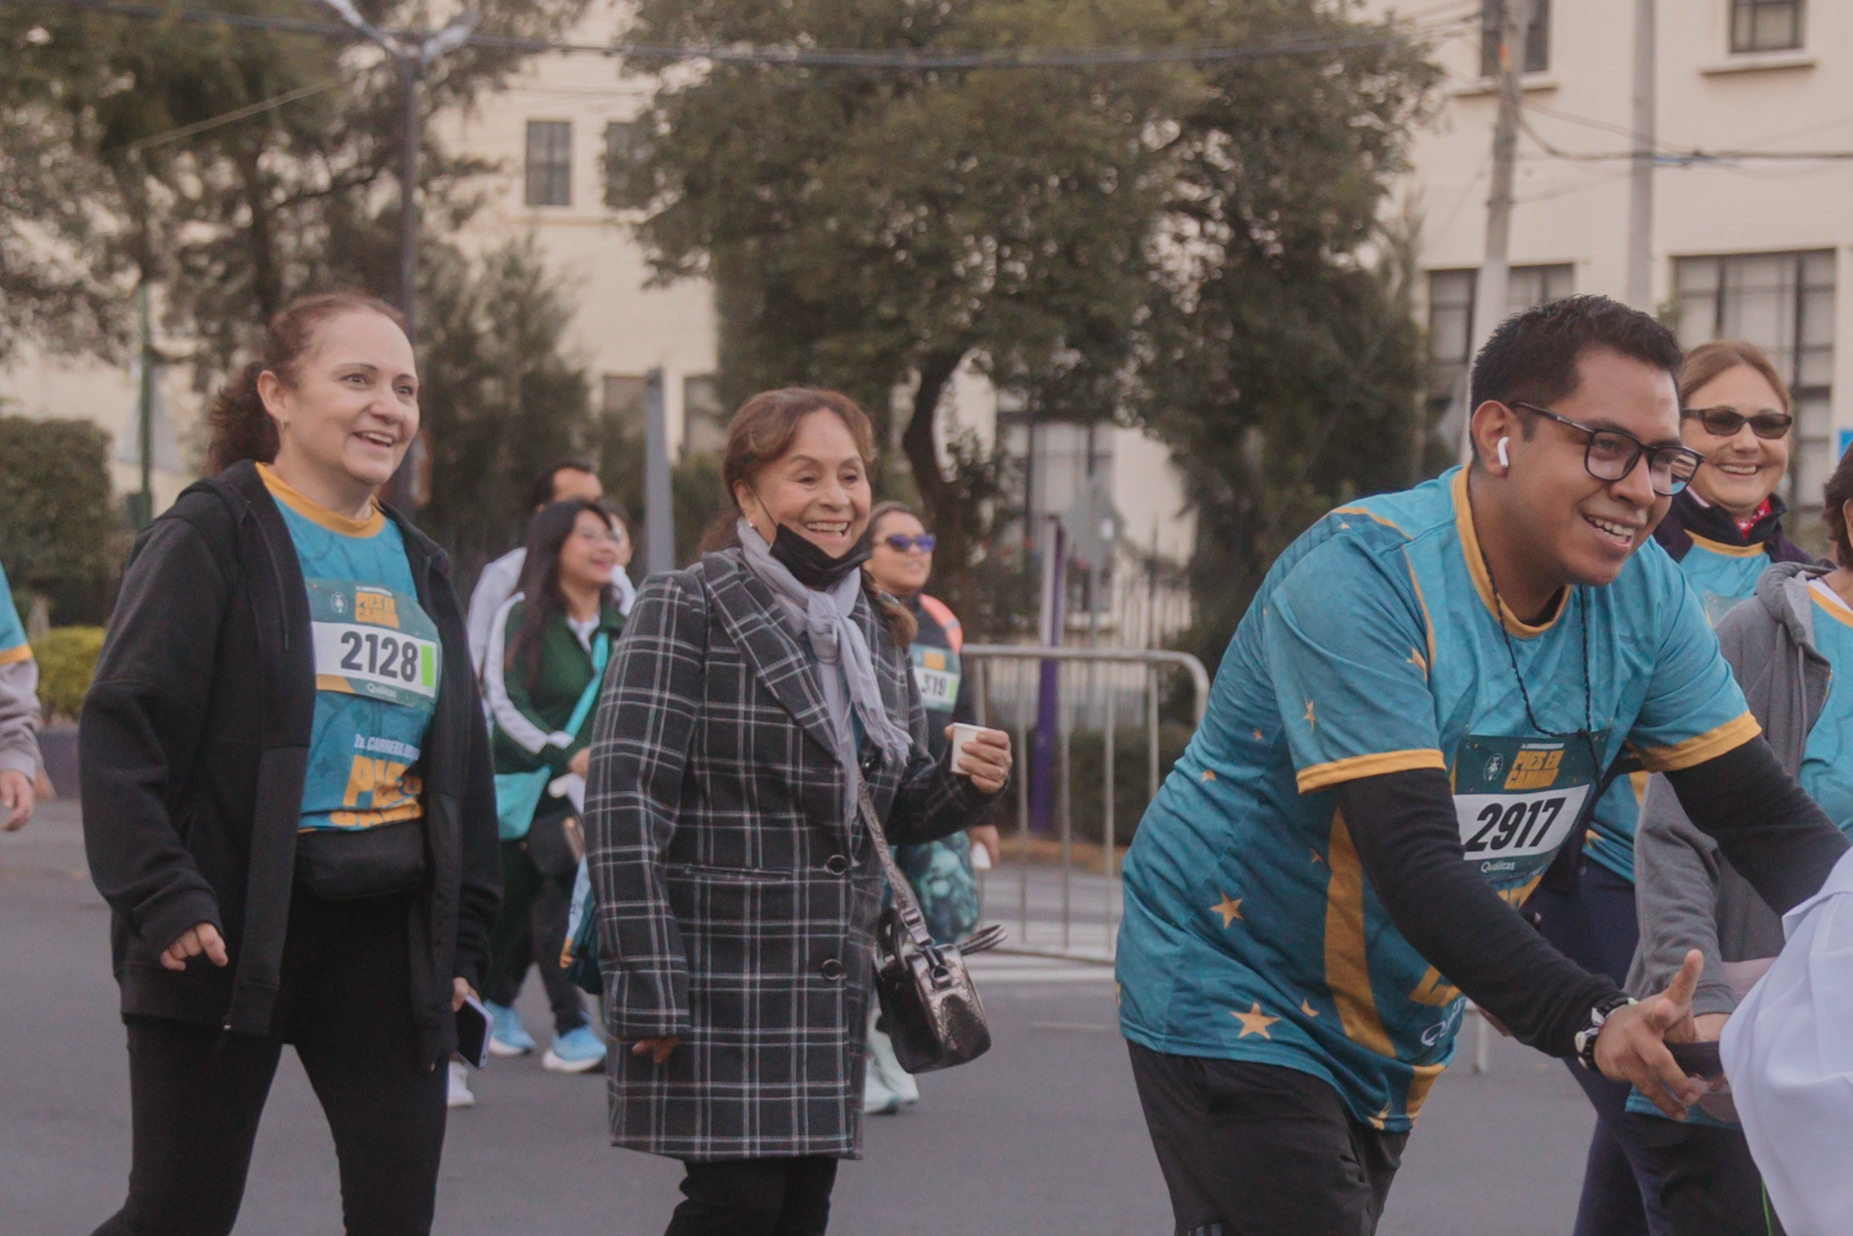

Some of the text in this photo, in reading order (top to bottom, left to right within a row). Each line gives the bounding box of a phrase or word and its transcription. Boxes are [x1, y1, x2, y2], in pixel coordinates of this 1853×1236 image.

[341, 631, 418, 682] 2128
[1512, 750, 1548, 770] PIES
[1504, 768, 1560, 789] CAMINO
[1465, 797, 1567, 852] 2917
